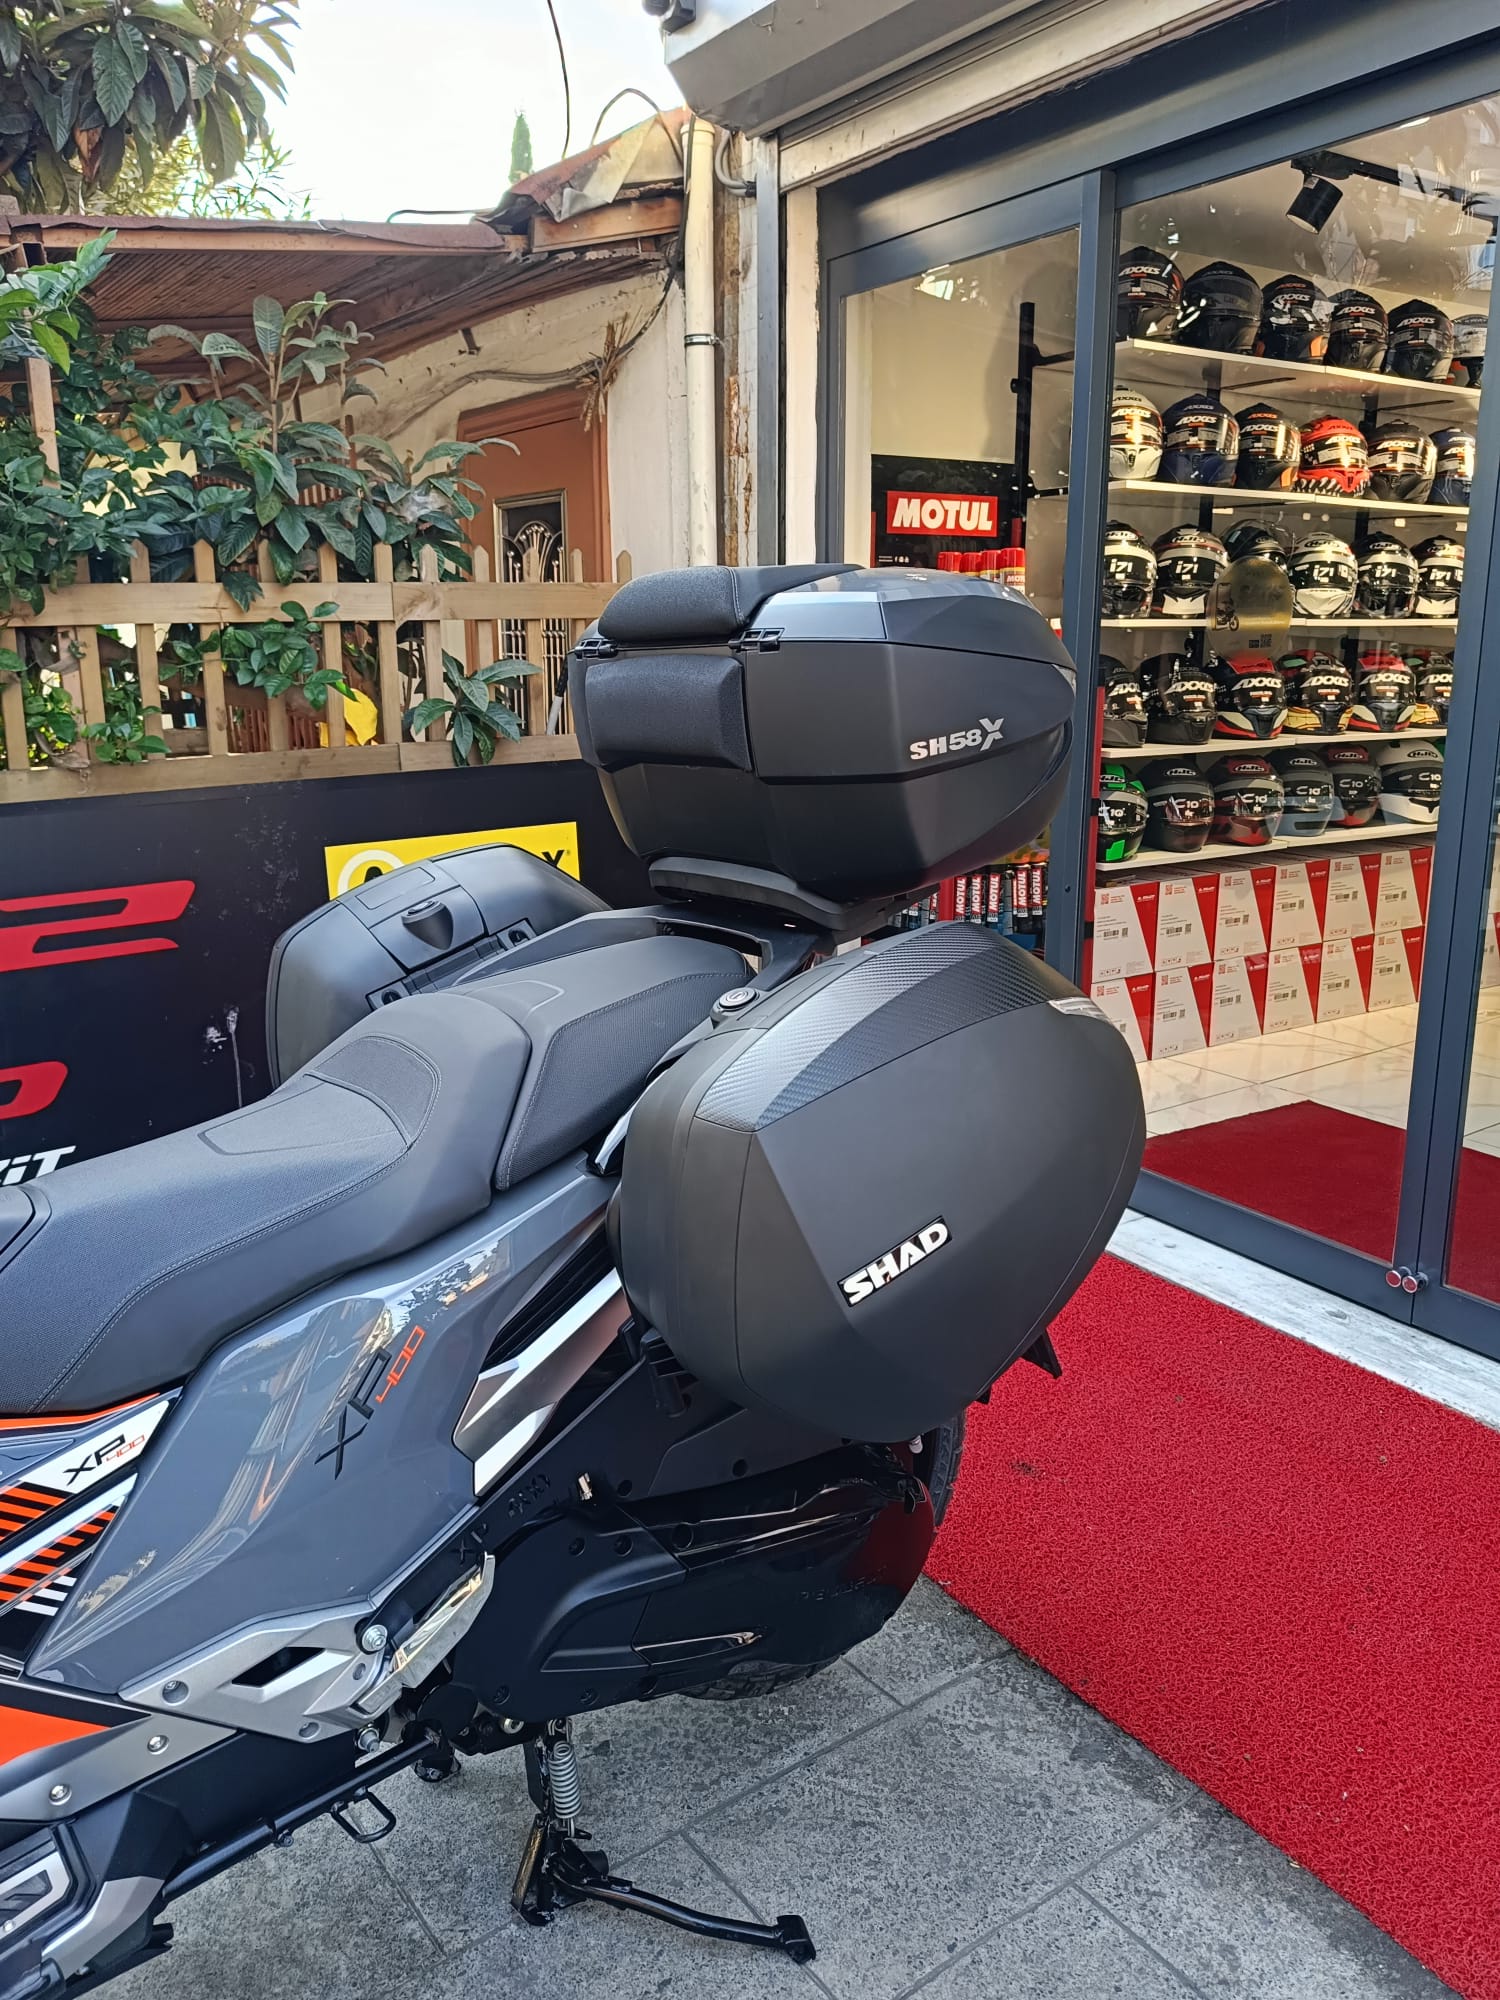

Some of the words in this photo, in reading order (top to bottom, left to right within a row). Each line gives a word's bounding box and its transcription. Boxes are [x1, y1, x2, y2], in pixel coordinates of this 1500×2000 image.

[1118, 266, 1161, 277] AXXIS
[1335, 305, 1376, 315] AXXIS
[1397, 317, 1436, 328] AXXIS
[1176, 416, 1217, 426] AXXIS
[1241, 424, 1279, 433] AXXIS
[1377, 440, 1416, 449] AXXIS
[892, 498, 993, 531] MOTUL
[1232, 677, 1282, 691] AXXIS
[1300, 675, 1349, 689] AXXIS
[1359, 672, 1410, 686] AXXIS
[1165, 681, 1215, 694] AXXIS
[909, 717, 1004, 760] SH58X
[1339, 778, 1364, 788] C10
[971, 875, 981, 912] MOTUL
[989, 875, 999, 912] MOTUL
[1018, 870, 1027, 907] MOTUL
[1032, 868, 1041, 905] MOTUL
[955, 877, 966, 914] MOTUL
[843, 1222, 949, 1305] SHAD
[314, 1346, 392, 1480] XP
[375, 1324, 427, 1404] 400
[62, 1433, 126, 1486] XP
[106, 1434, 146, 1462] 400
